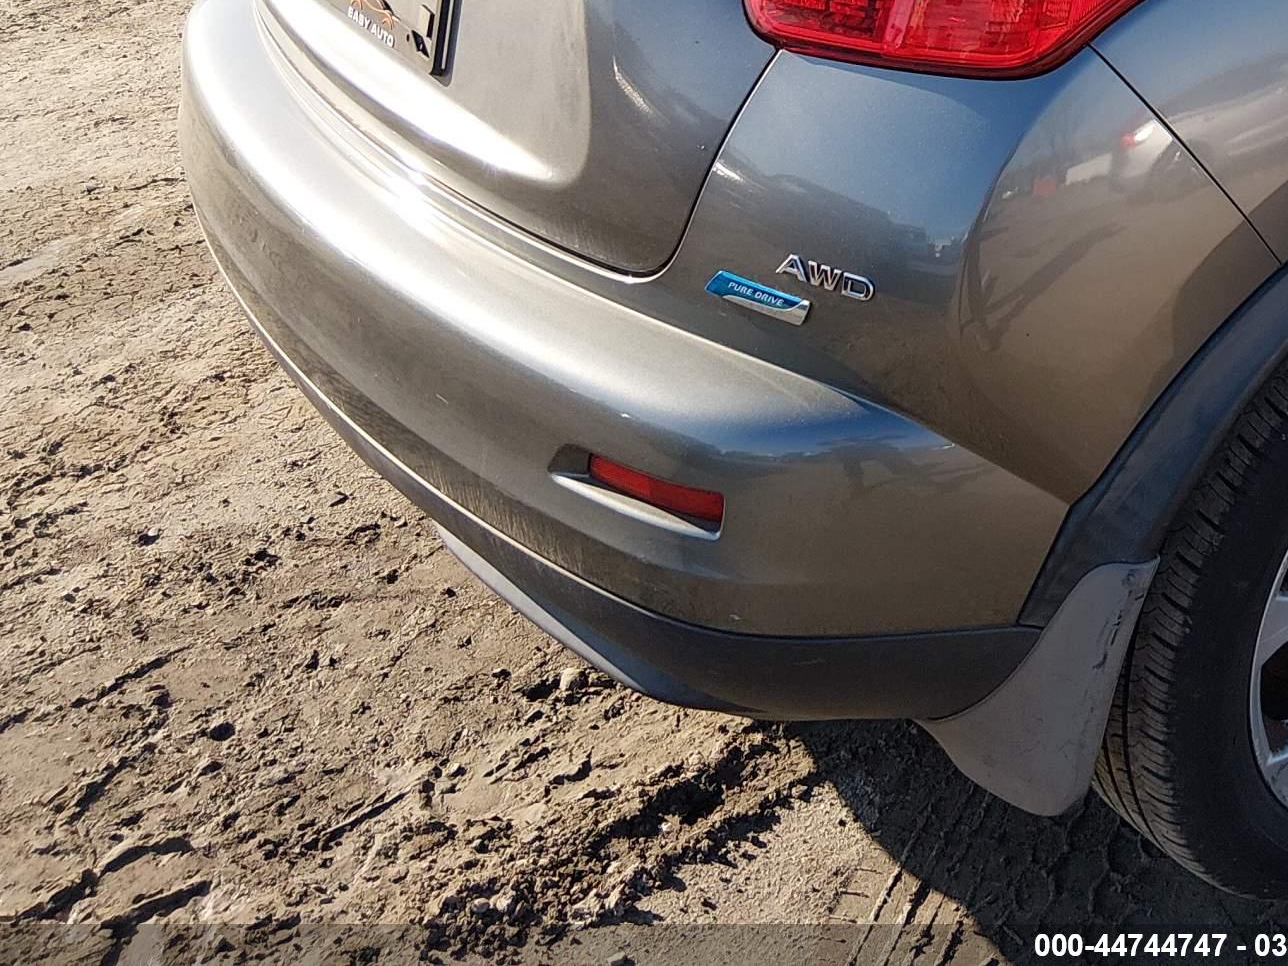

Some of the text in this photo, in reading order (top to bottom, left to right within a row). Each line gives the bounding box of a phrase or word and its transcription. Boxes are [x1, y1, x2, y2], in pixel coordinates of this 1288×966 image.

[347, 6, 396, 48] BABY AUTO
[728, 281, 785, 308] PURE DRIVE
[775, 253, 876, 301] AWD
